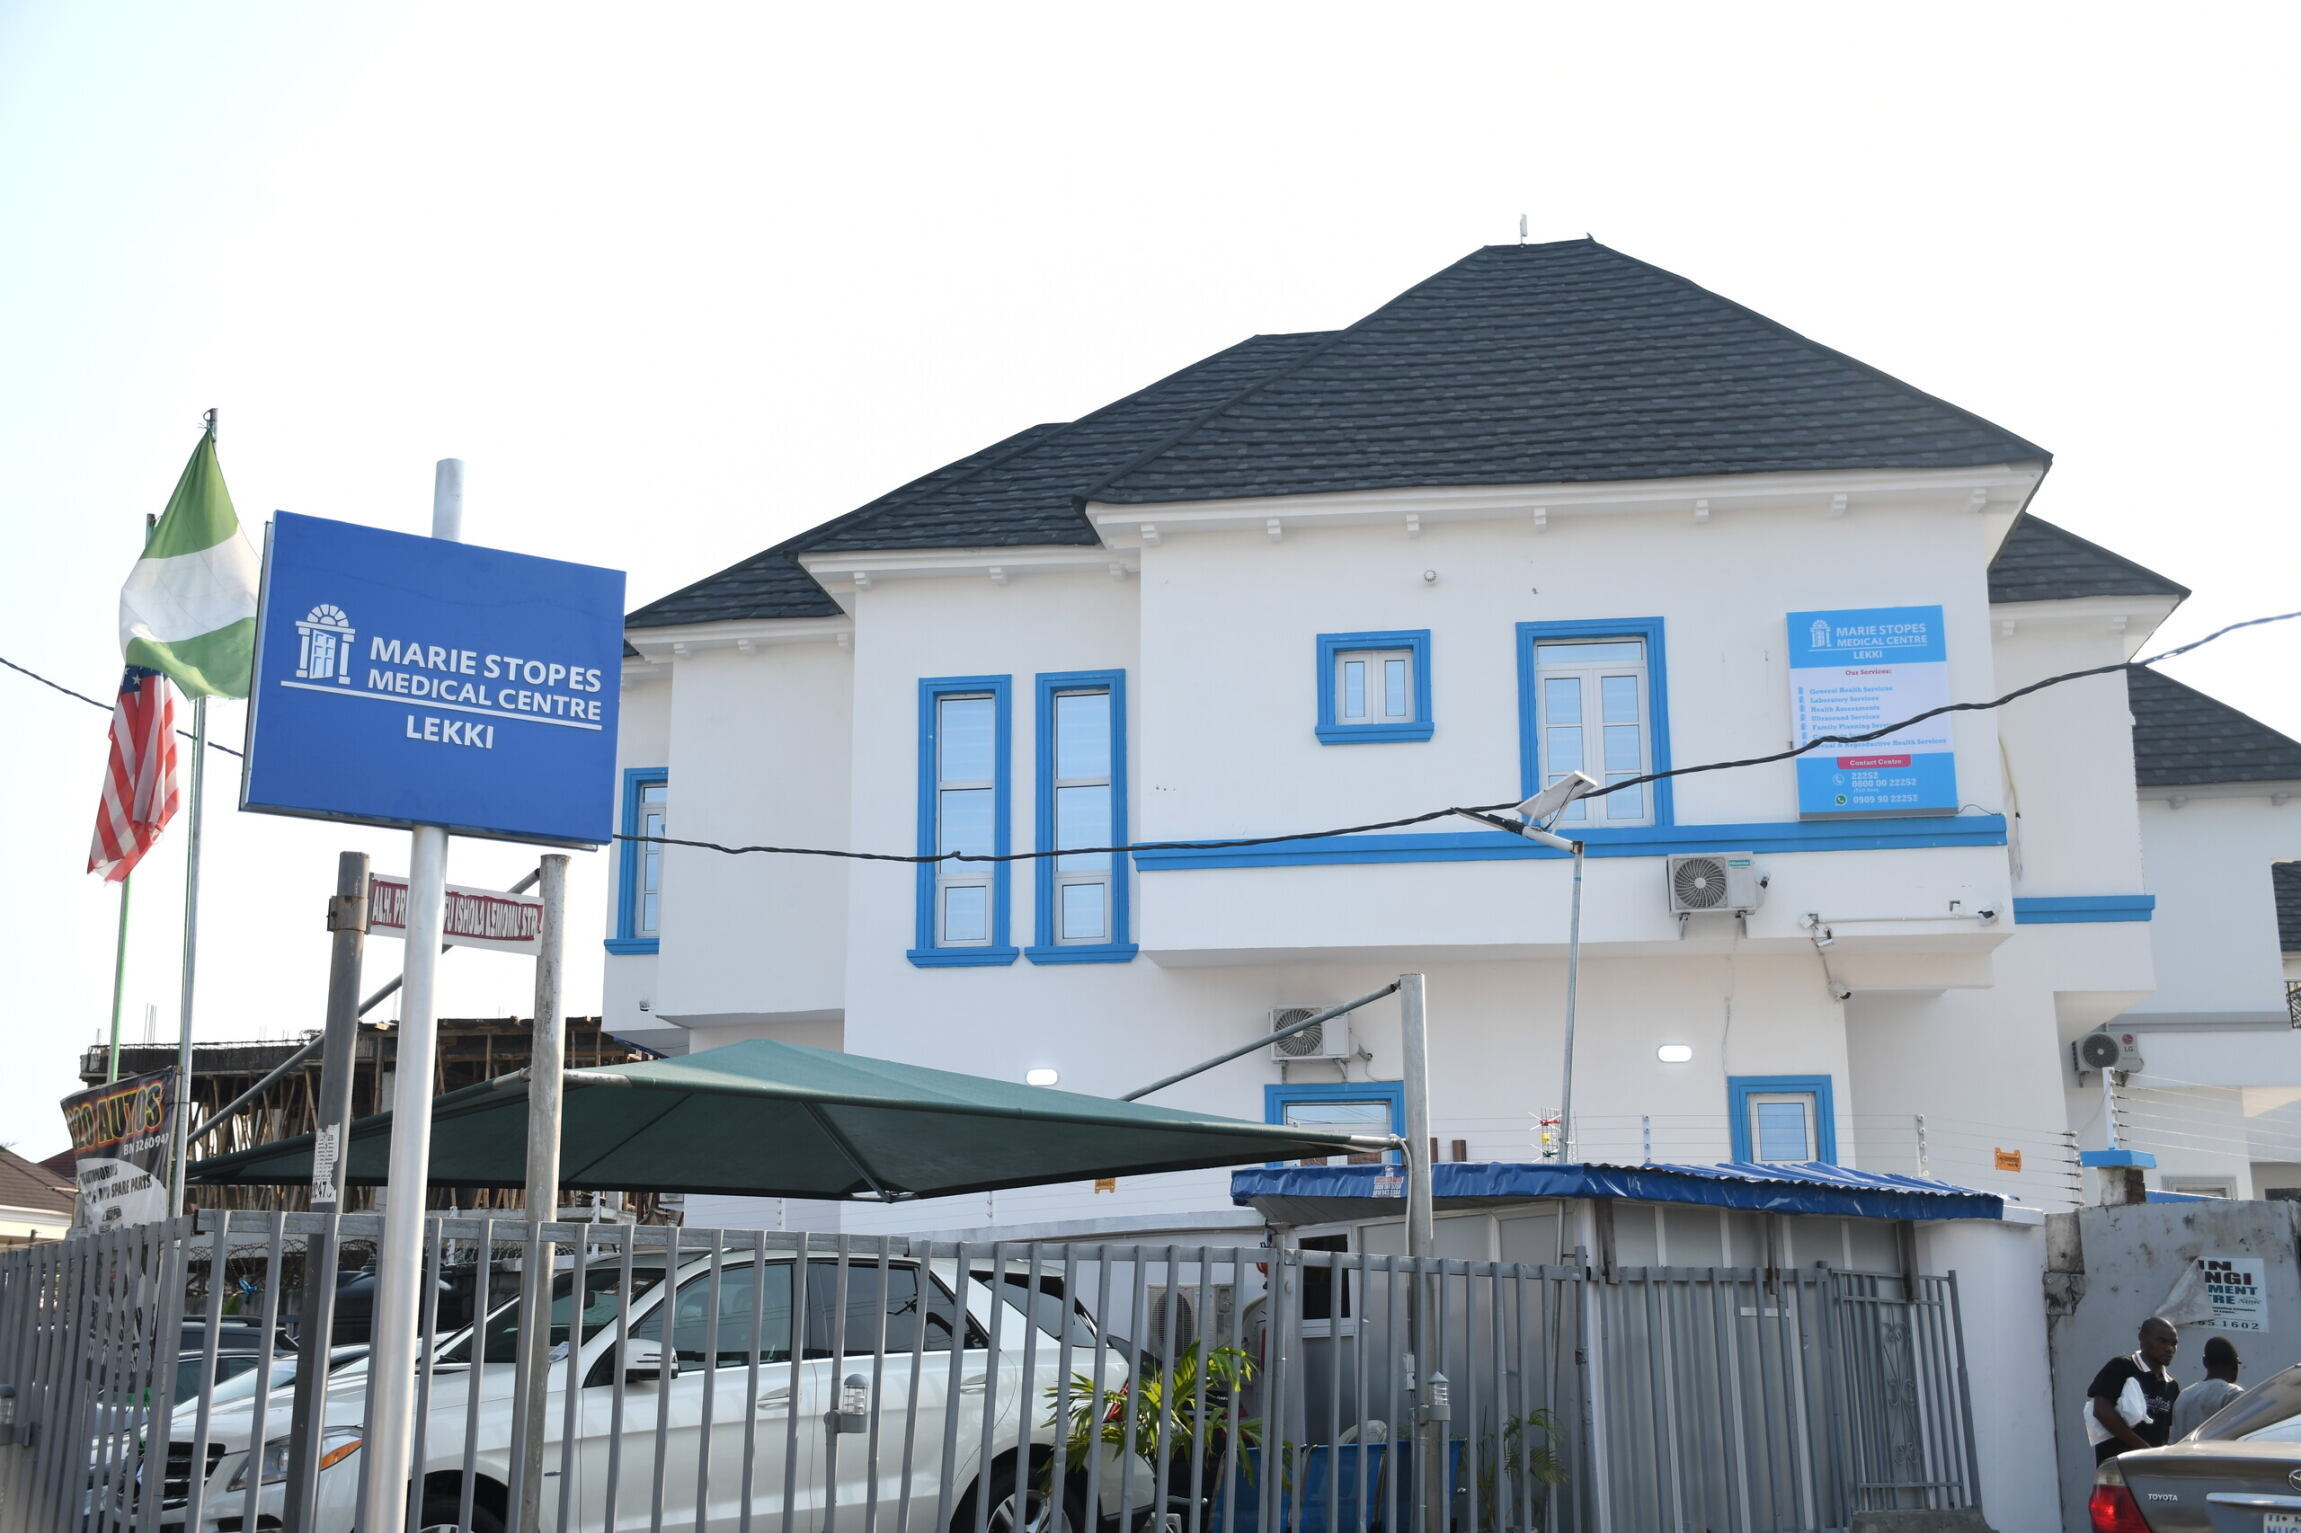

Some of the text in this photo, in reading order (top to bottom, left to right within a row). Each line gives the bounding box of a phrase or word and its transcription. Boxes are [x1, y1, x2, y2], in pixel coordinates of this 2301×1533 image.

[1836, 623, 1927, 637] MARIE STOPES
[1837, 635, 1928, 647] MEDICAL CENTRE
[1853, 650, 1883, 660] LEKKI
[369, 636, 602, 694] MARIE STOPES
[367, 668, 602, 722] MEDICAL CENTRE
[1839, 686, 1862, 694] Health
[1863, 685, 1893, 693] Services
[1811, 705, 1834, 713] Health
[406, 714, 495, 750] LEKKI
[1812, 723, 1837, 731] Family
[1839, 722, 1869, 730] Planning
[97, 1081, 165, 1145] AUTOS
[111, 1179, 131, 1197] SPARE
[2208, 1285, 2258, 1295] MENT
[2148, 1493, 2178, 1502] TOYOTA
